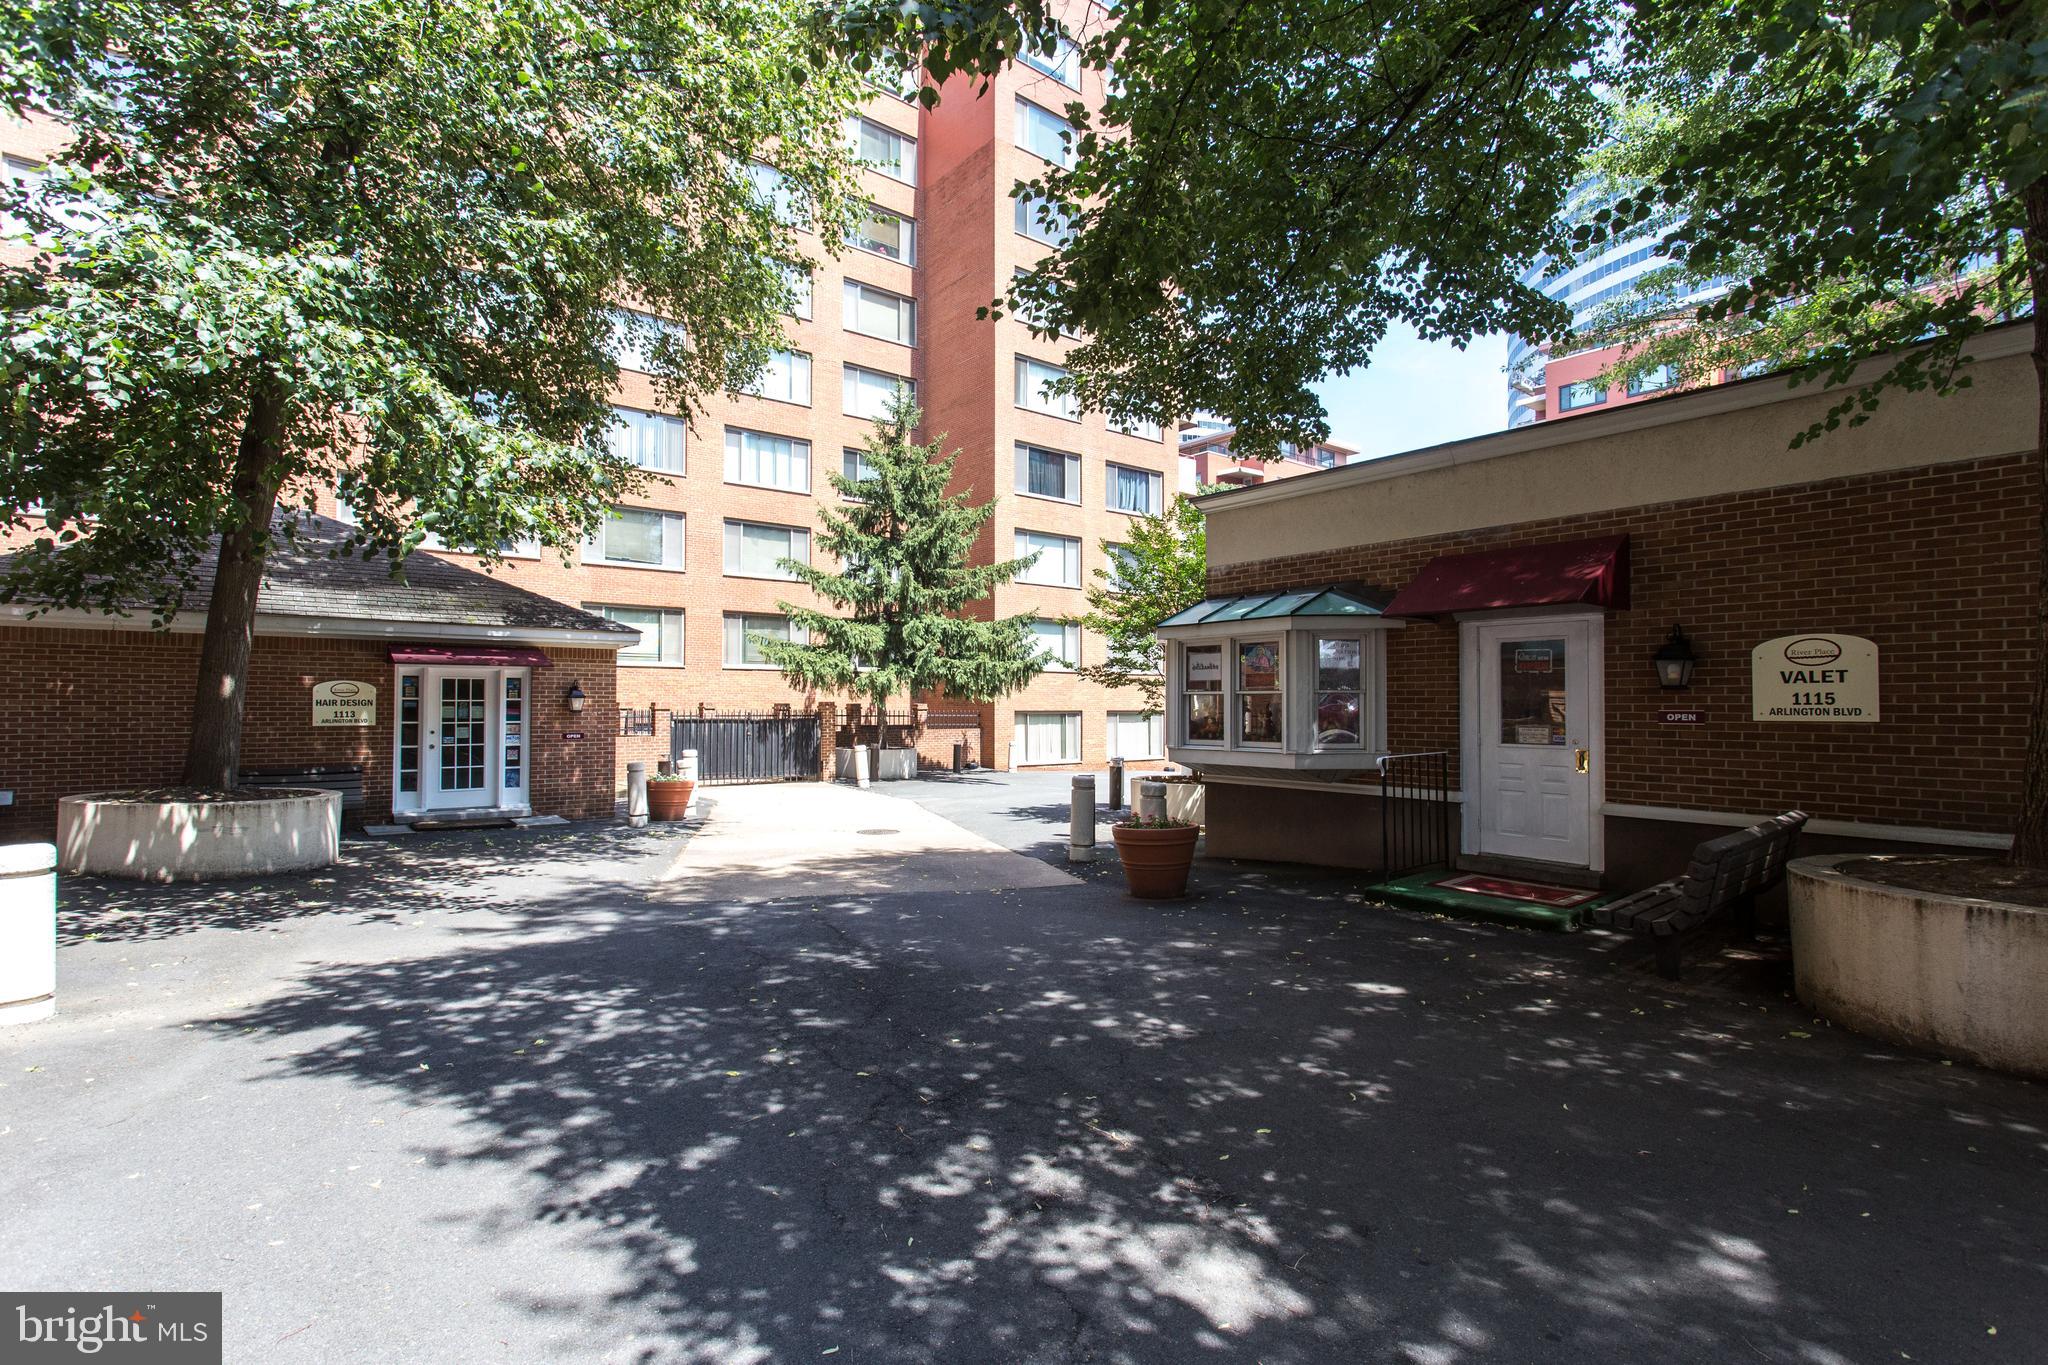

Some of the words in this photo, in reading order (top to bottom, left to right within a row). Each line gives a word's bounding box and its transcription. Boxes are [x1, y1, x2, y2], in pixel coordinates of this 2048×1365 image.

[1791, 648, 1813, 656] River
[1814, 647, 1836, 655] Place
[1780, 669, 1849, 684] VALET
[315, 699, 338, 707] HAIR
[340, 699, 374, 707] DESIGN
[1792, 692, 1836, 706] 1115
[333, 710, 356, 718] 1113
[1769, 707, 1831, 716] ARLINGTON
[1833, 707, 1863, 717] BLVD
[1666, 713, 1697, 721] OPEN
